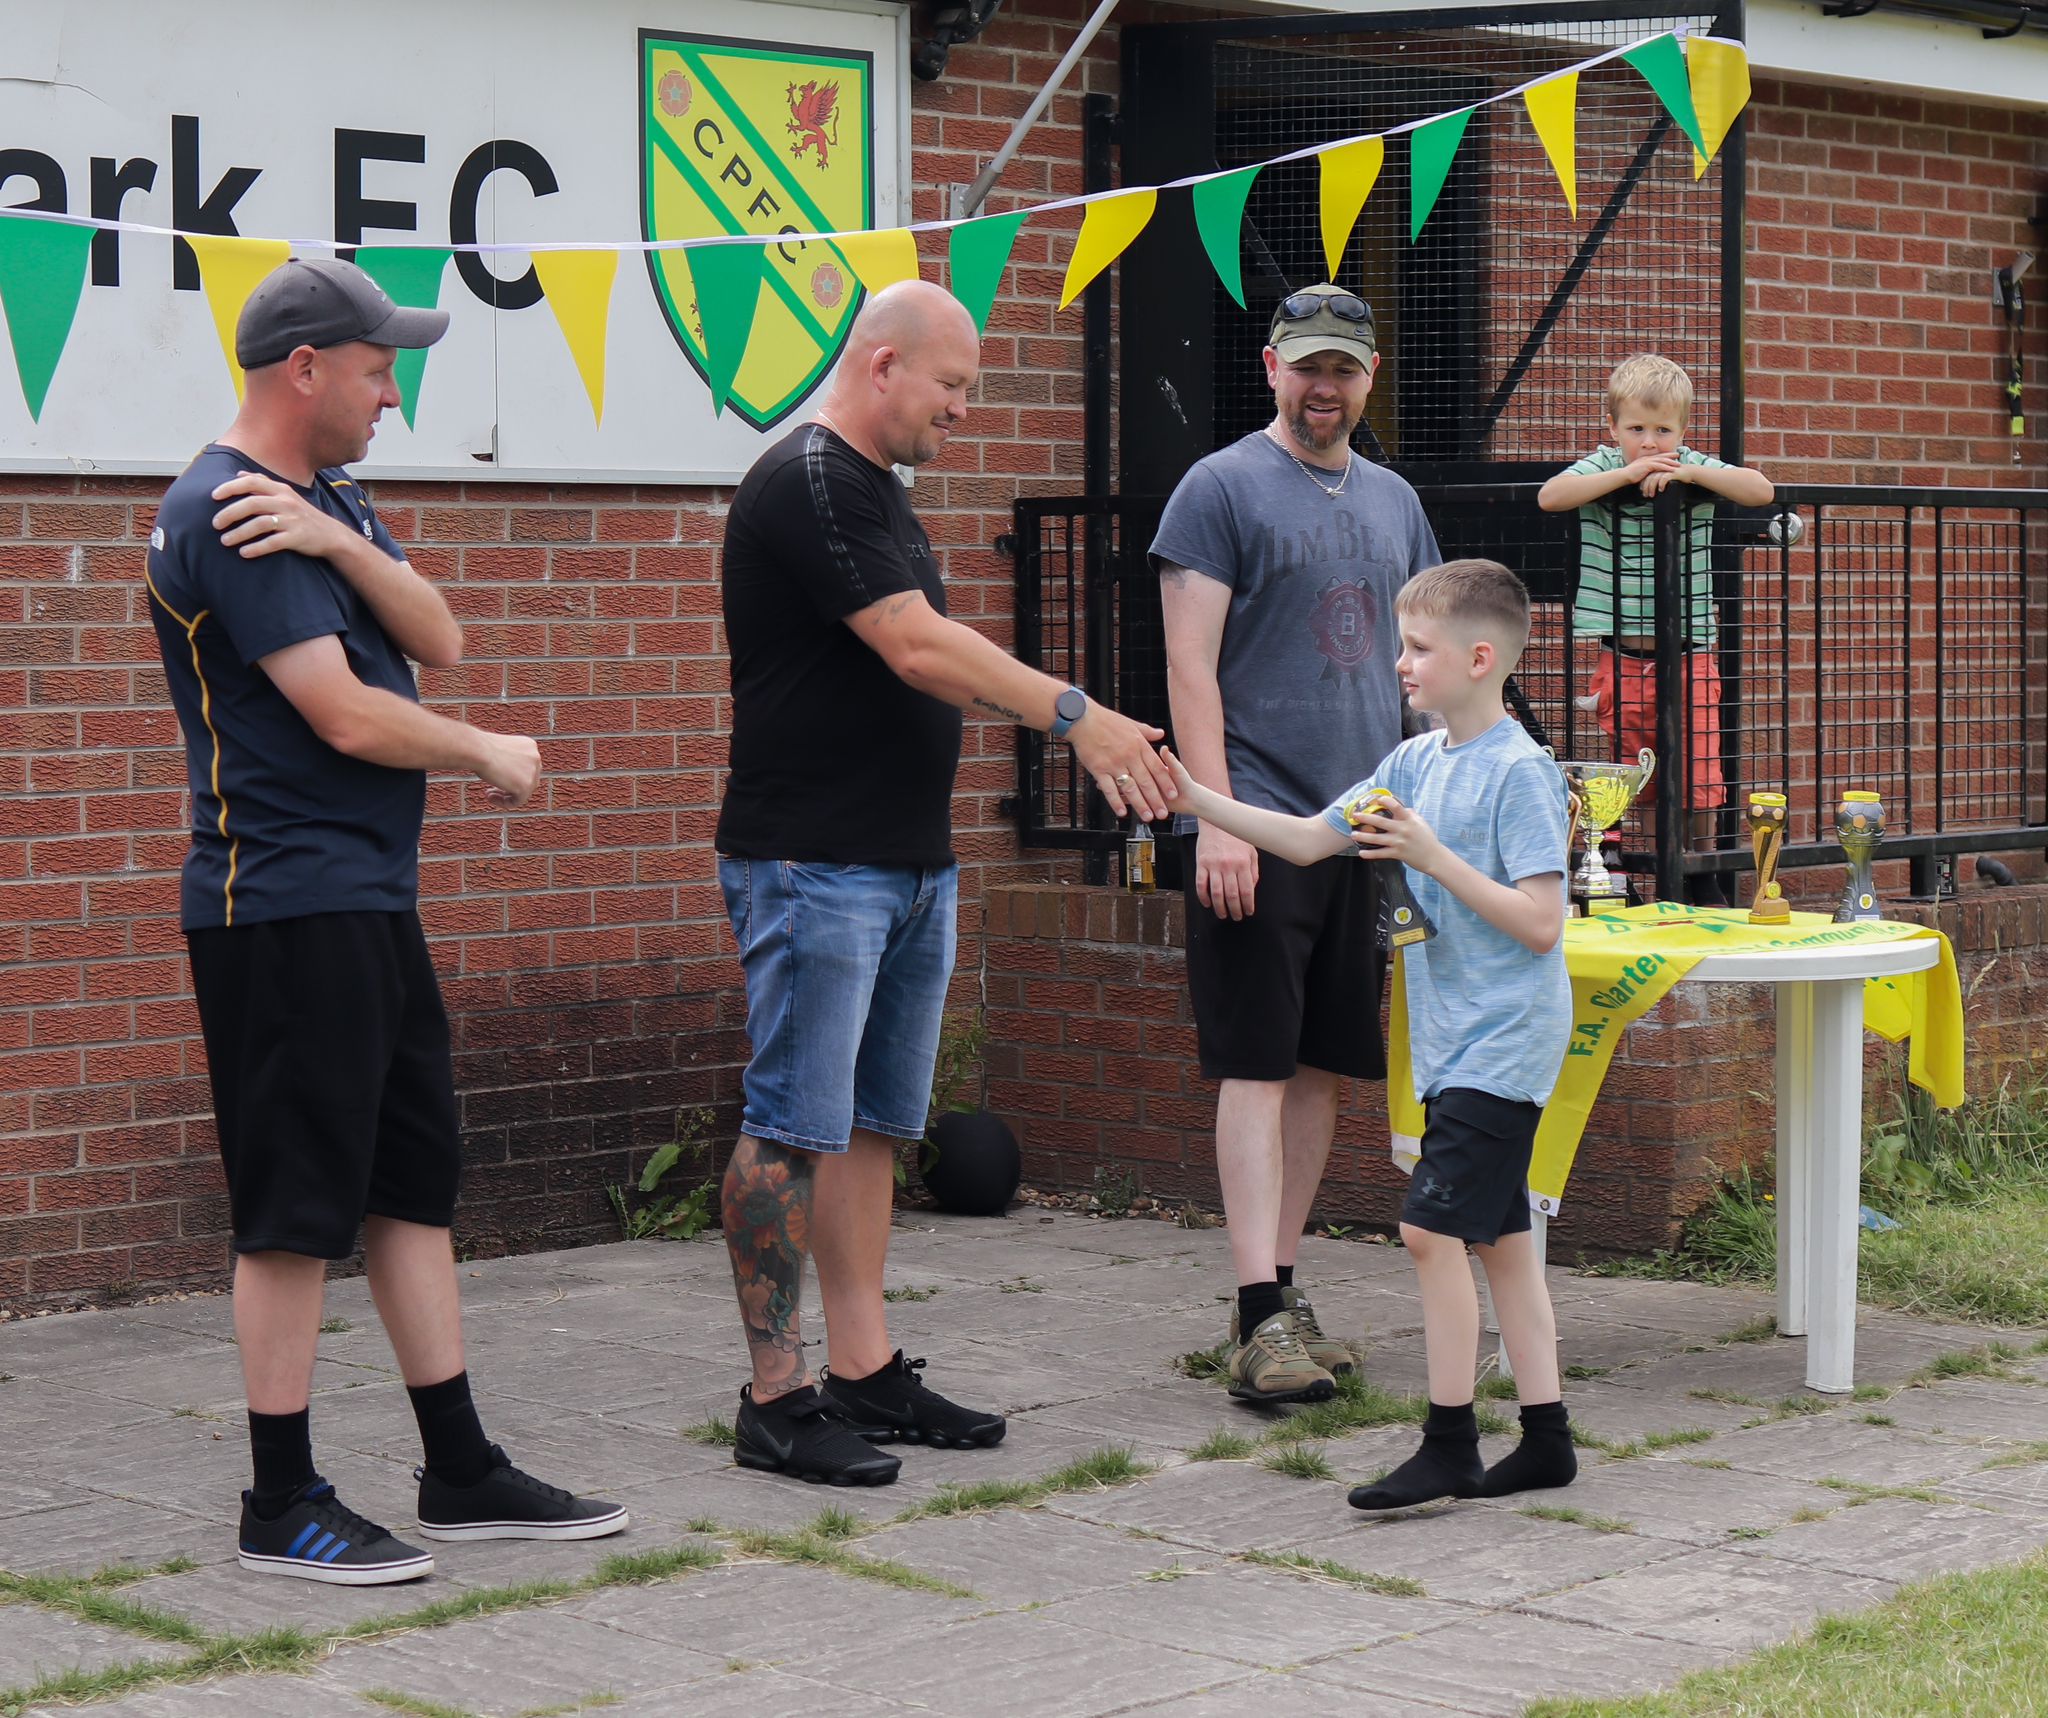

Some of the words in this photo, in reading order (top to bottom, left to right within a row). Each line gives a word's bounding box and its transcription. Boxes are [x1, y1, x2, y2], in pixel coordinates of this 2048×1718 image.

[334, 127, 560, 310] FC
[693, 118, 807, 265] CPFC
[1568, 1017, 1609, 1056] F.A.
